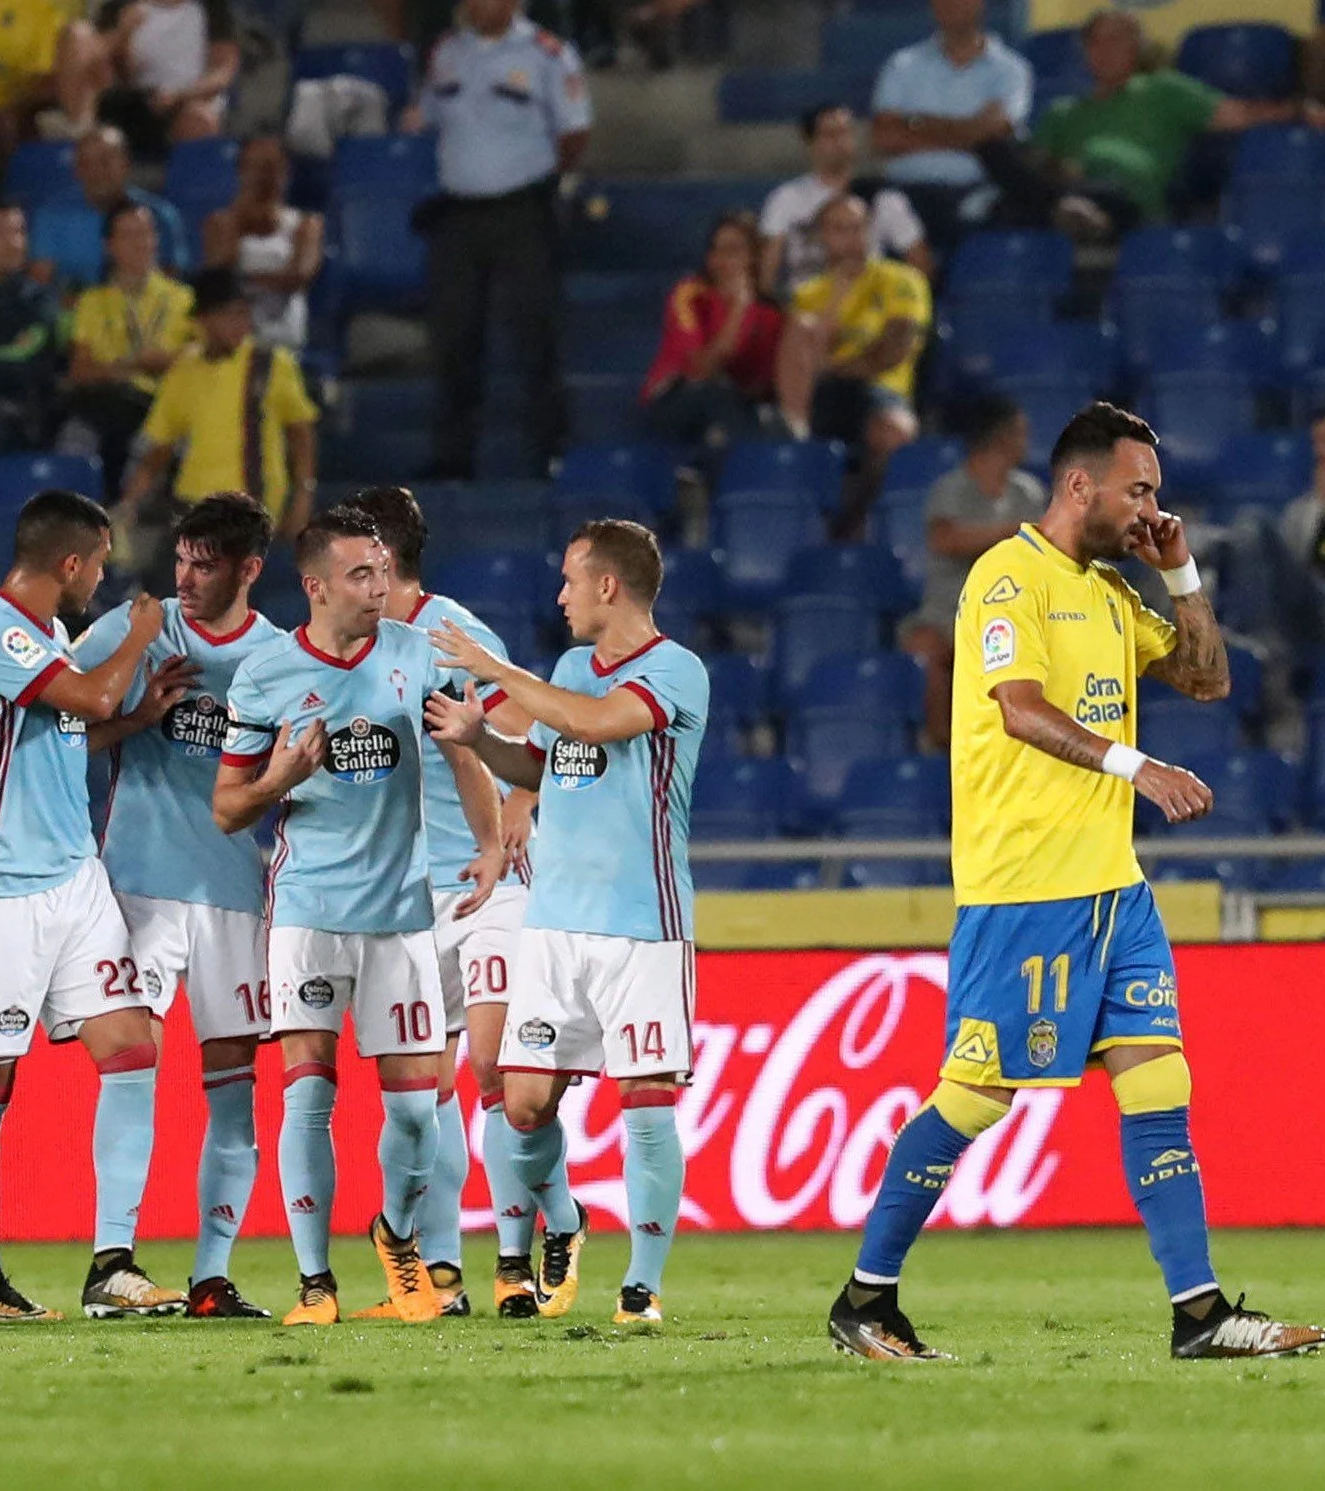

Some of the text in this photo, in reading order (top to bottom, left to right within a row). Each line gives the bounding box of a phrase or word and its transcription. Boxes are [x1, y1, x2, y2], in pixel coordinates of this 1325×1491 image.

[331, 734, 393, 755] Estrella
[334, 751, 392, 771] Galicia
[555, 740, 598, 759] Estrlla
[95, 956, 143, 1000] 22
[468, 955, 508, 998] 20
[1021, 953, 1071, 1015] 11
[388, 1000, 433, 1046] 10
[619, 1020, 667, 1068] 14
